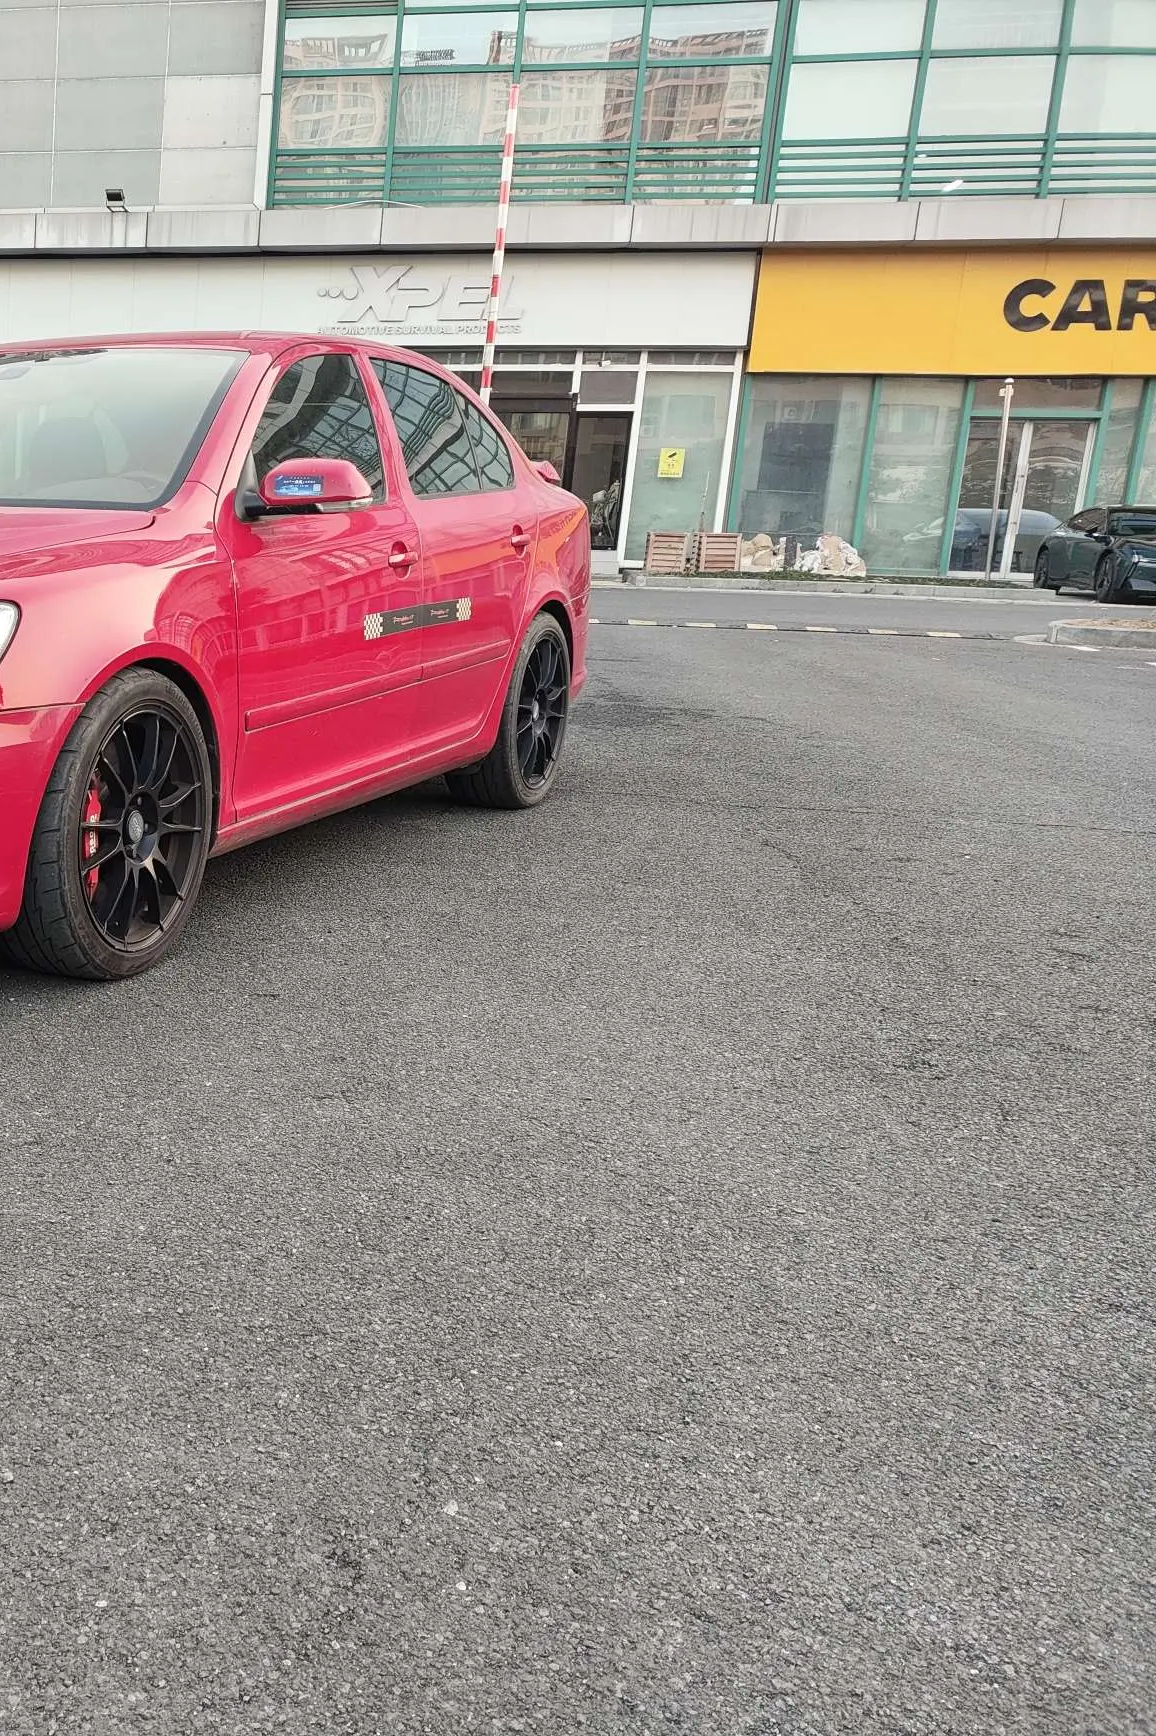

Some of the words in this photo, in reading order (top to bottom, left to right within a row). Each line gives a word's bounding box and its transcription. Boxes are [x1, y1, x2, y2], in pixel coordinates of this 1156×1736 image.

[337, 265, 524, 323] XPEL
[1003, 278, 1156, 332] CAR
[318, 325, 393, 335] AUTOMOTIVE
[395, 325, 453, 335] SURVIVAL
[457, 325, 522, 335] PRODCTS
